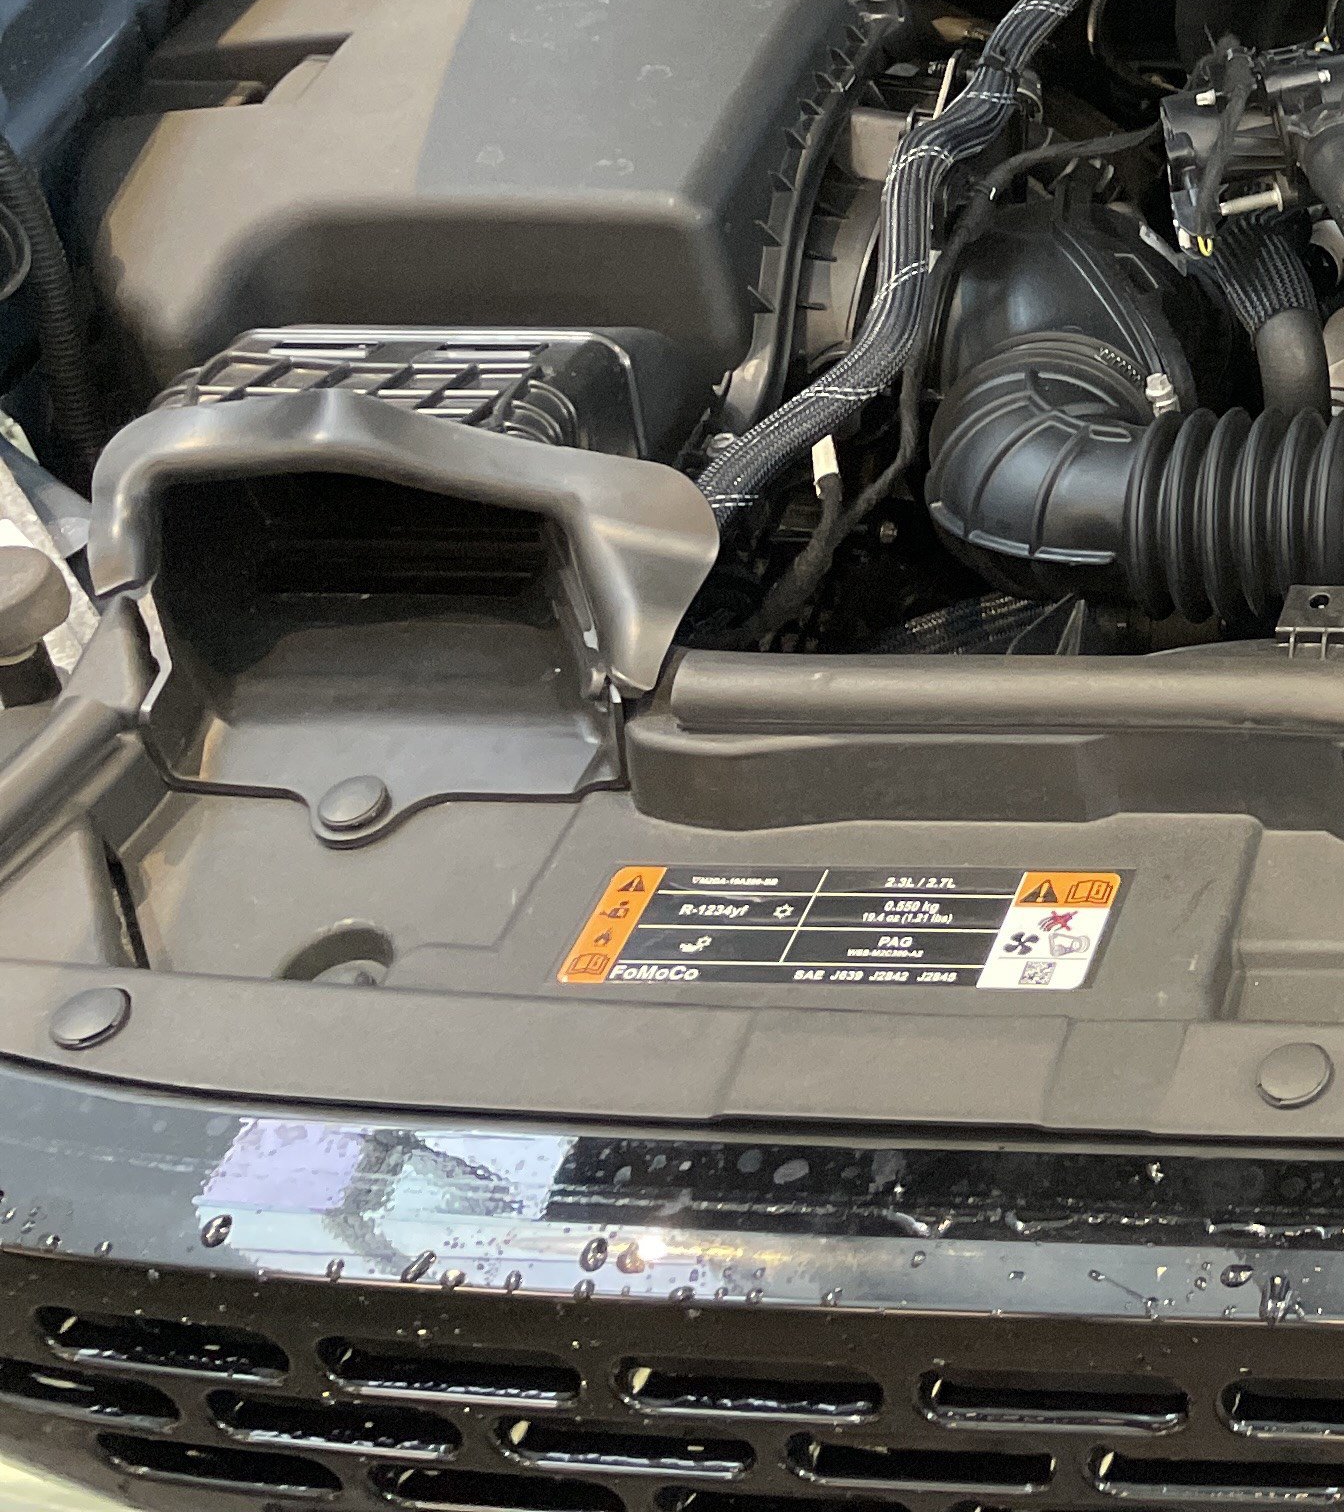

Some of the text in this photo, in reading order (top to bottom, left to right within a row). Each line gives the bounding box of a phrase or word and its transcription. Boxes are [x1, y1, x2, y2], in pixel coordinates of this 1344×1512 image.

[885, 876, 915, 889] 2.3L
[926, 877, 956, 889] 2.7L
[678, 903, 750, 919] R-1234yf
[922, 901, 940, 914] kg
[877, 935, 913, 948] PAG
[609, 964, 700, 981] FoMoCo
[793, 969, 826, 981] SAE
[829, 970, 864, 982] J639
[868, 970, 910, 982] J2842
